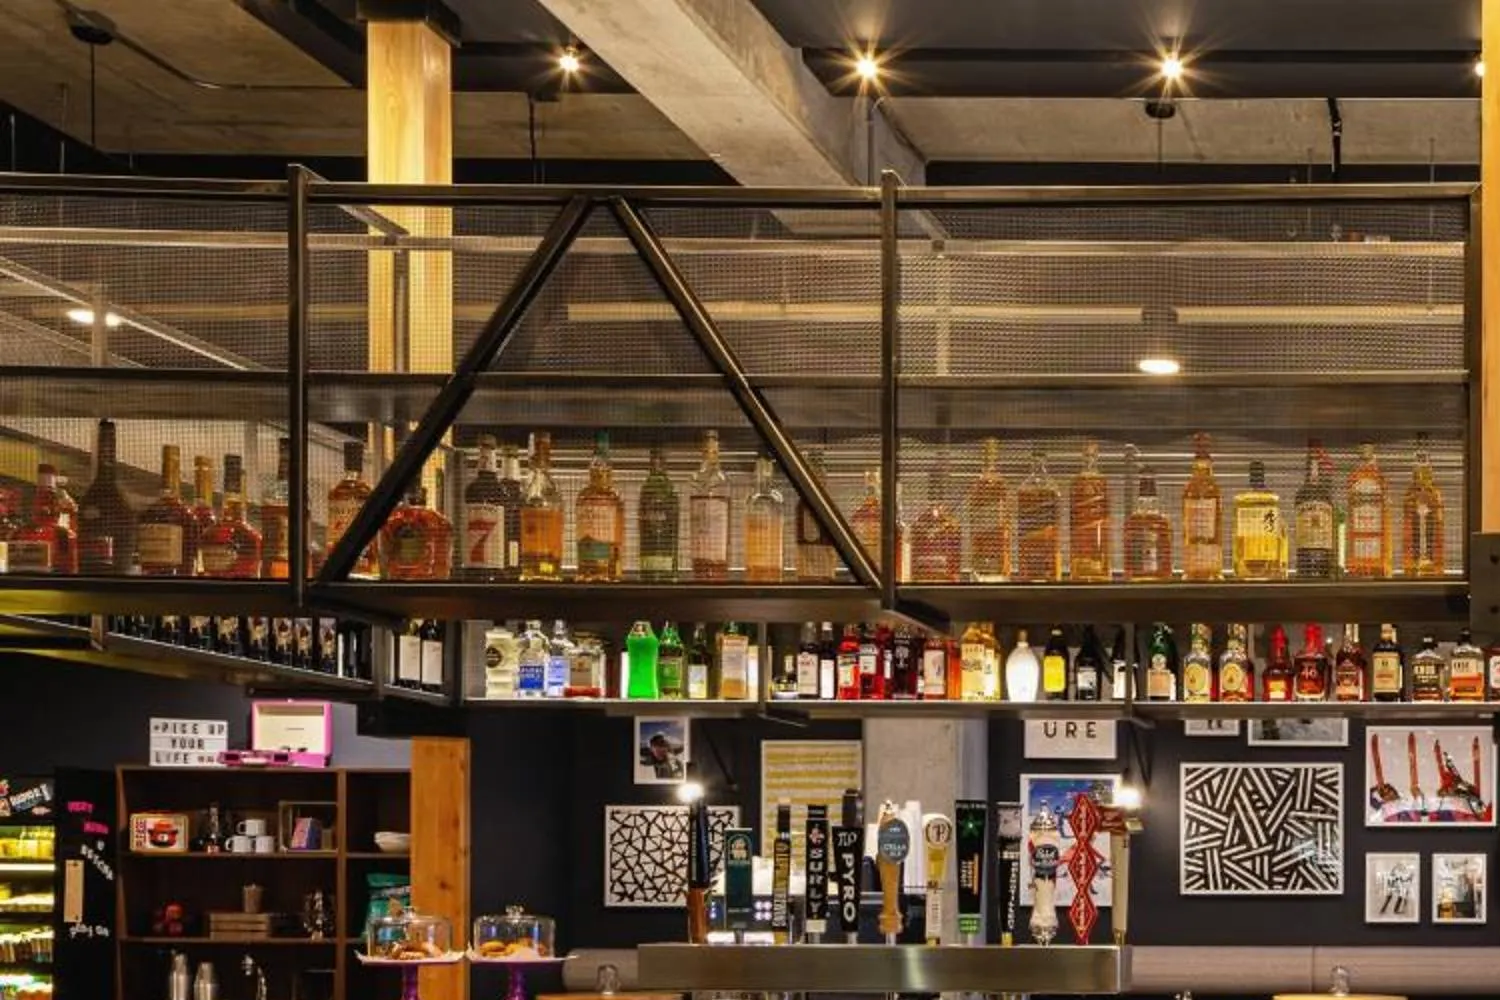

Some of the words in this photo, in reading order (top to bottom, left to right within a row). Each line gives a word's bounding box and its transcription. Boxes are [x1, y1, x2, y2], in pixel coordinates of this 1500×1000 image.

[468, 519, 497, 563] 7
[155, 752, 189, 765] LIFE
[171, 738, 205, 750] YOUR
[809, 850, 824, 915] SURLY
[841, 853, 858, 923] PYRO
